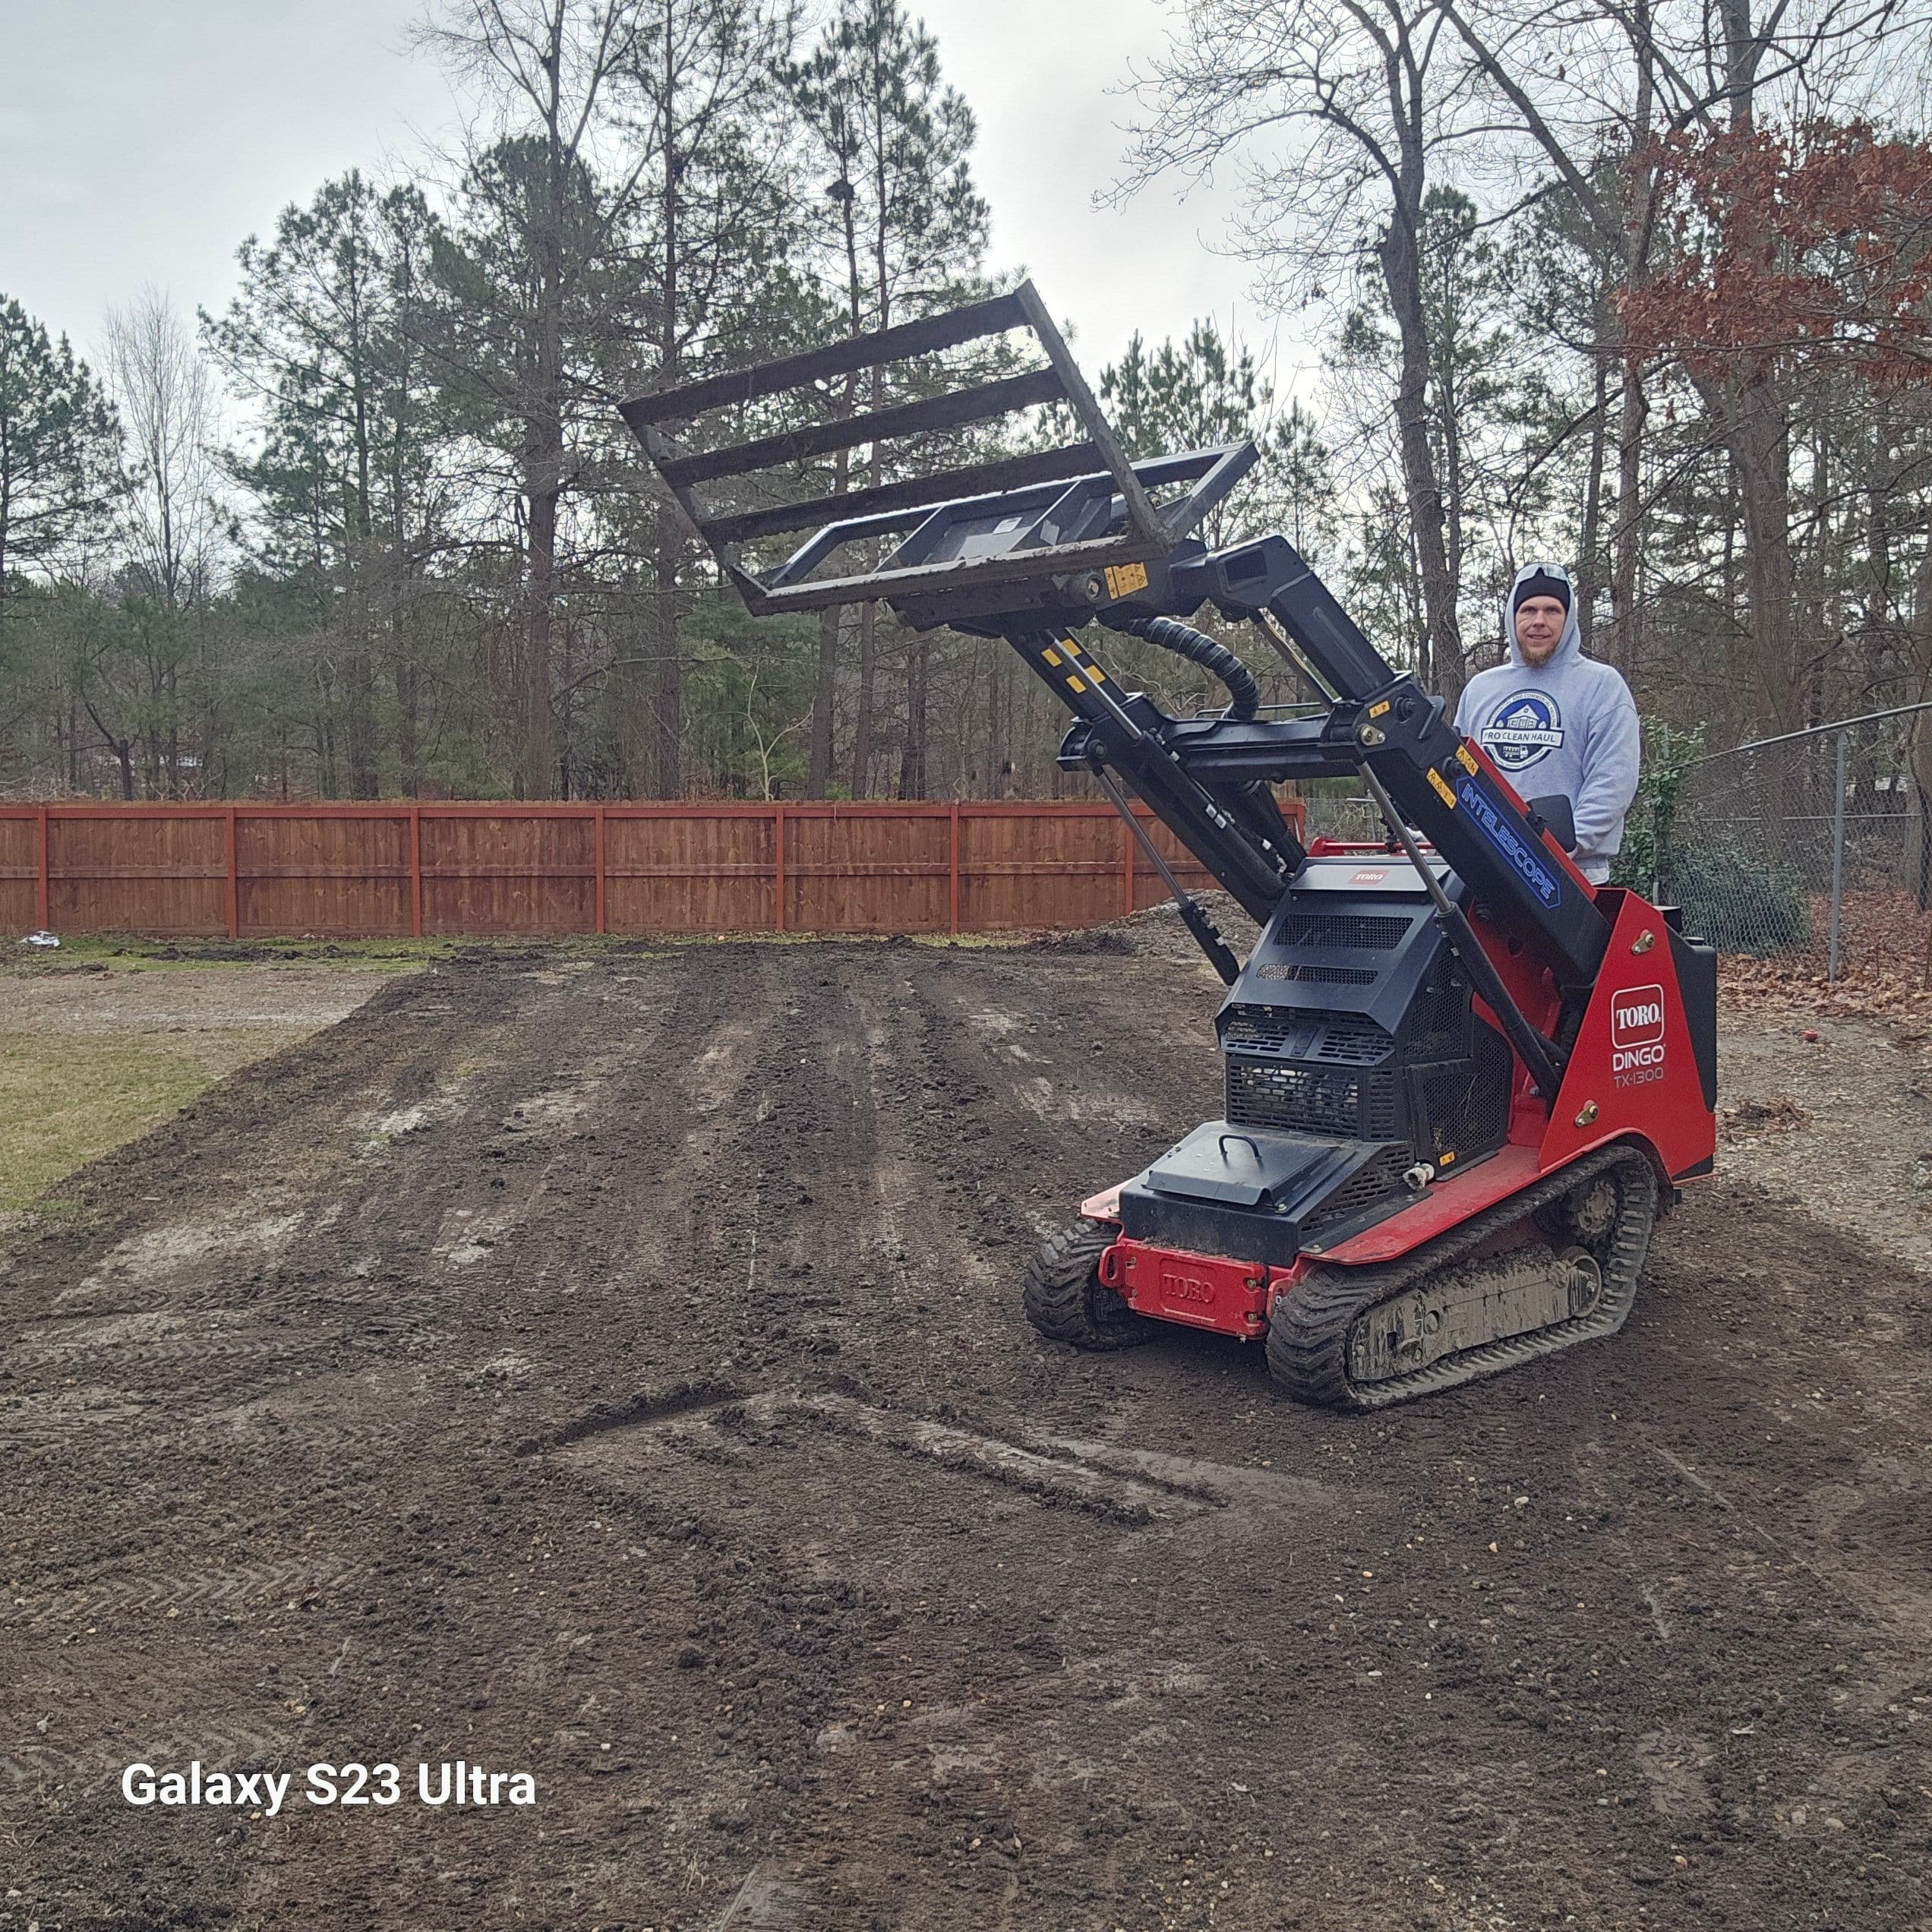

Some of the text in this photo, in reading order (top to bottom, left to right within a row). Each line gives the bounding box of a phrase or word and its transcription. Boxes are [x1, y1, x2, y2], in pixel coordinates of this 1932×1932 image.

[1502, 732, 1530, 740] CLEAN
[1531, 733, 1555, 742] HAUL
[1461, 783, 1555, 899] INTELESCOPE
[1616, 1003, 1660, 1029] TORO
[1612, 1045, 1665, 1072] DINGO
[1163, 1274, 1215, 1303] TORO
